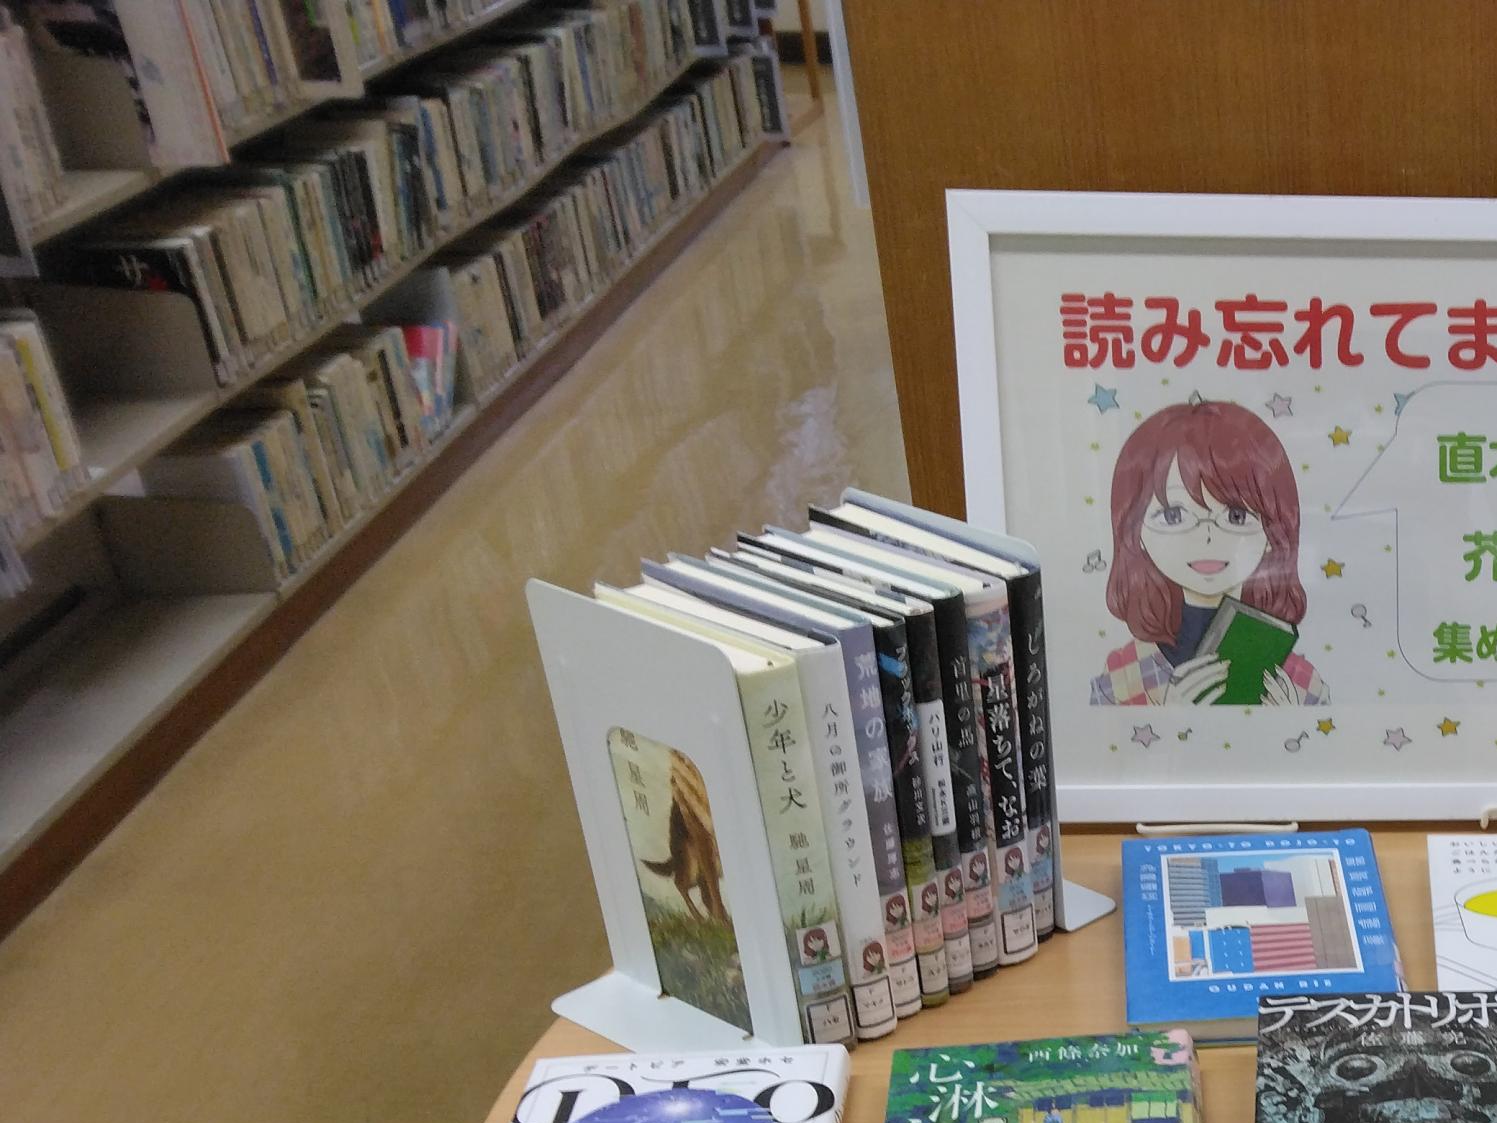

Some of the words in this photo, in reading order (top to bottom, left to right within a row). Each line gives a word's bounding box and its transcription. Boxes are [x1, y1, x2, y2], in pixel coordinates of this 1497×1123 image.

[762, 699, 807, 815] 少年と犬
[1027, 632, 1048, 793] しろがねの葉
[822, 703, 861, 887] 八月の御所グラウンド
